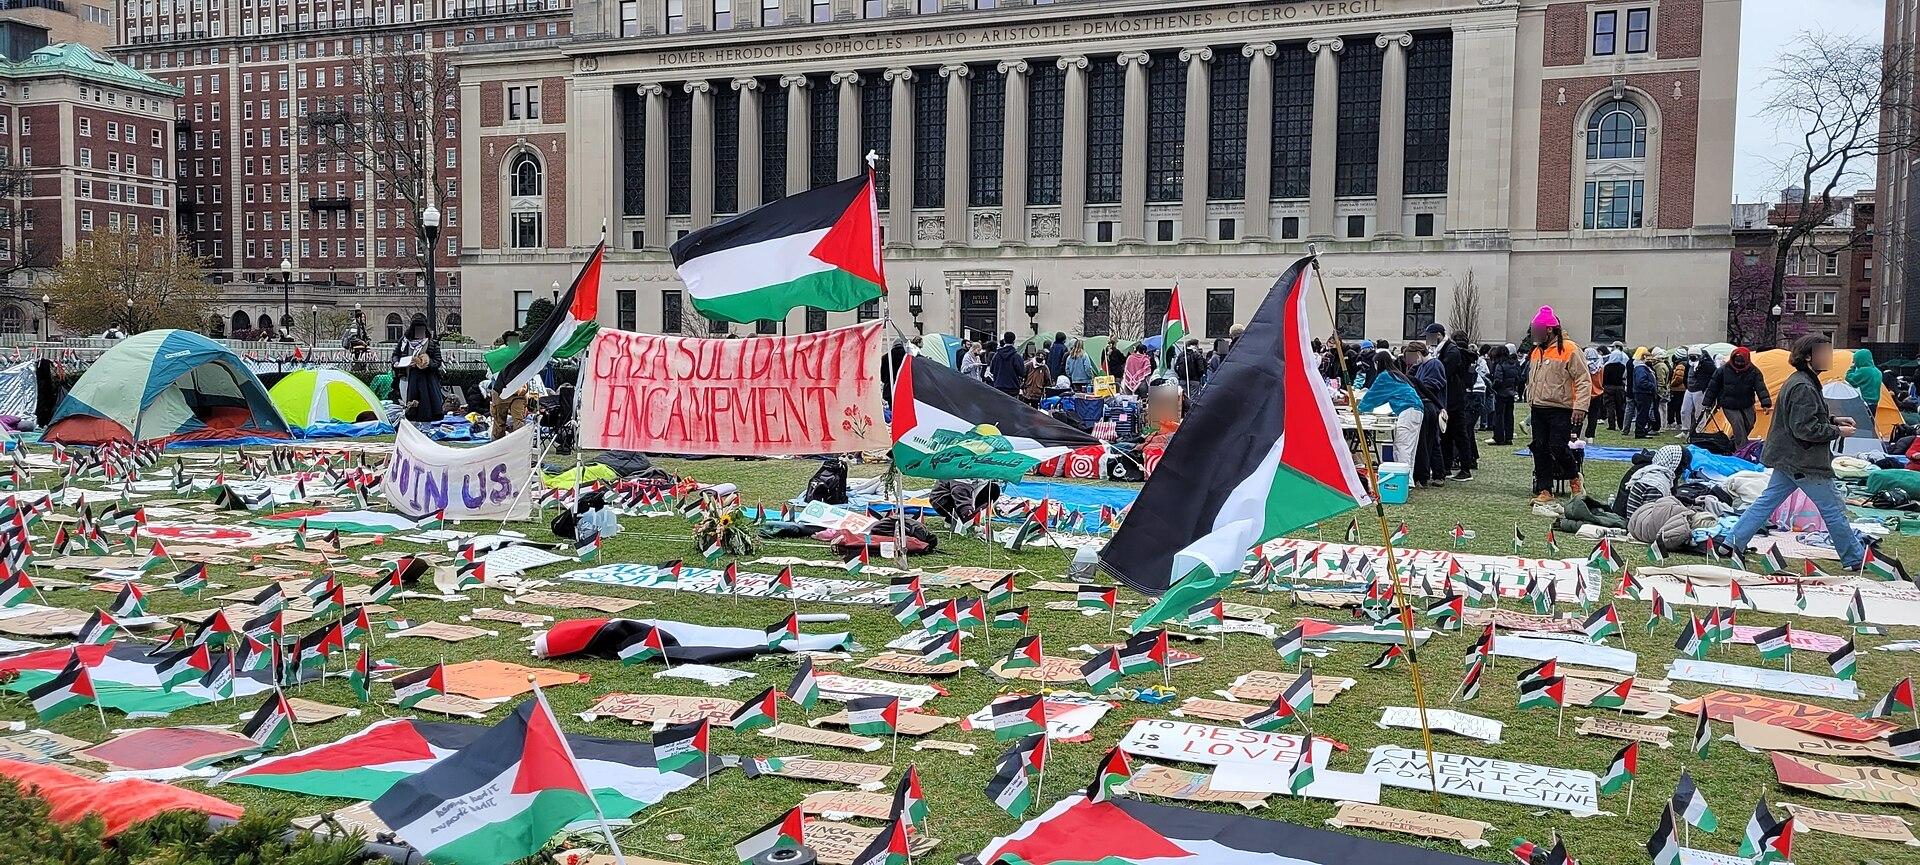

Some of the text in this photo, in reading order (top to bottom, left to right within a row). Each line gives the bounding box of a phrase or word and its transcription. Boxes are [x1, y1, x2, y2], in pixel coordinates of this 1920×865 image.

[658, 0, 1382, 65] HOMER HERODOTUS SOPHOCLES PLATO ARISTOTLE DEMOSTHENES CICERO VERGIL
[594, 332, 670, 381] GAZA
[602, 385, 838, 443] ENCAMPMENT
[391, 447, 449, 513] JOIN
[1018, 669, 1058, 680] FOR
[1192, 700, 1255, 713] DIVEST
[1139, 733, 1160, 741] IS
[1147, 721, 1316, 748] TO RESIS
[1131, 740, 1301, 762] TO LOVE
[784, 761, 883, 777] CEASE
[1372, 758, 1590, 793] AMERICANS
[1374, 767, 1598, 808] FOR PALESTINE
[1791, 806, 1877, 824] FREE
